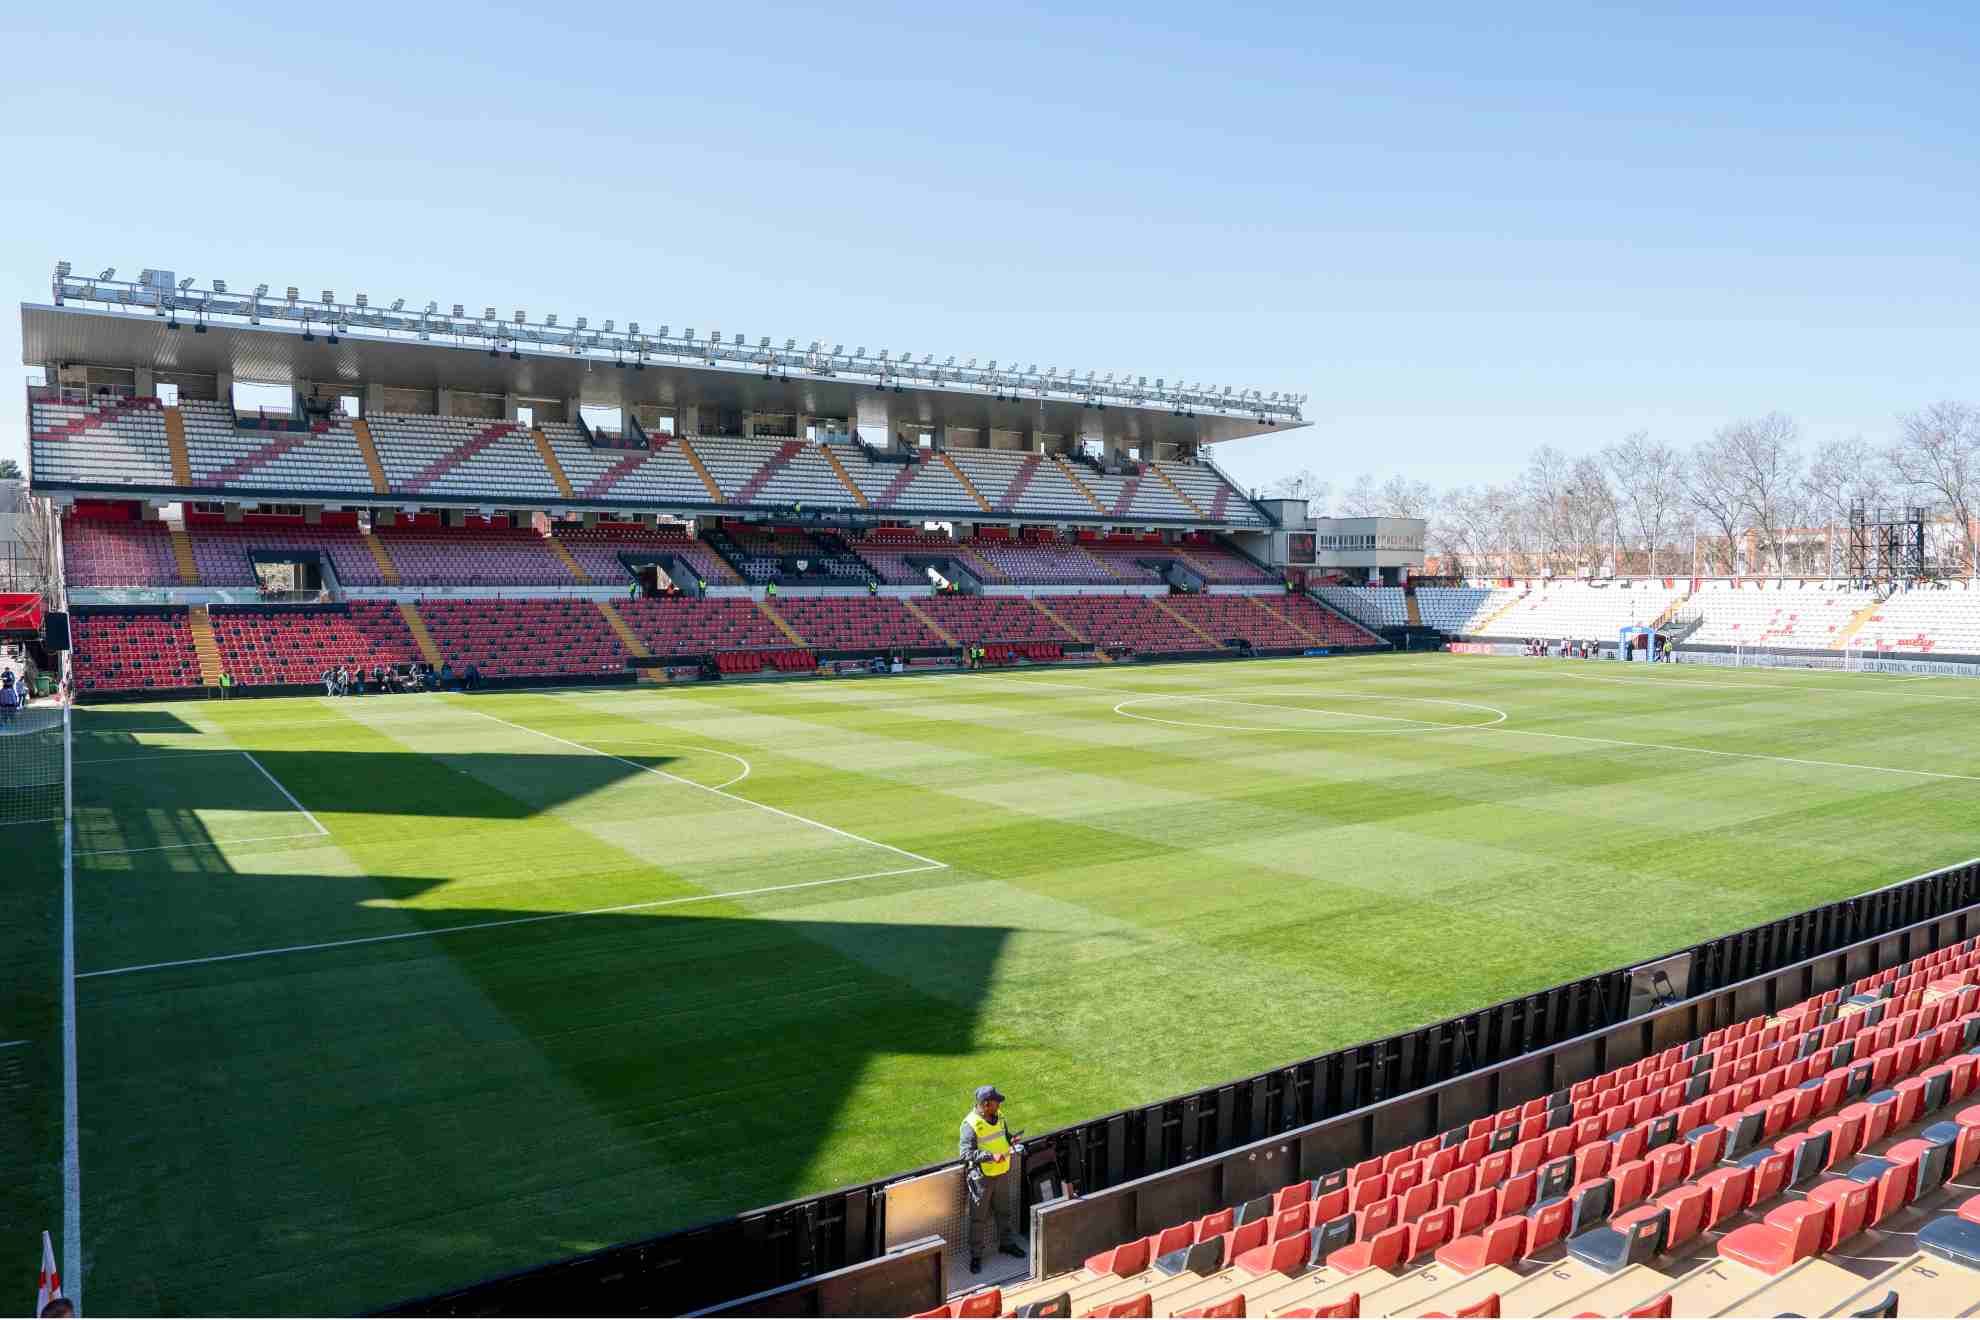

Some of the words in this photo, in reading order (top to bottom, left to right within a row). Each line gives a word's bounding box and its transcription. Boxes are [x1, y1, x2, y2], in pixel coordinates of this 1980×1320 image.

[1420, 1271, 1438, 1281] 5
[1552, 1270, 1573, 1280] 6
[1705, 1268, 1728, 1281] 7
[1911, 1265, 1939, 1279] 8
